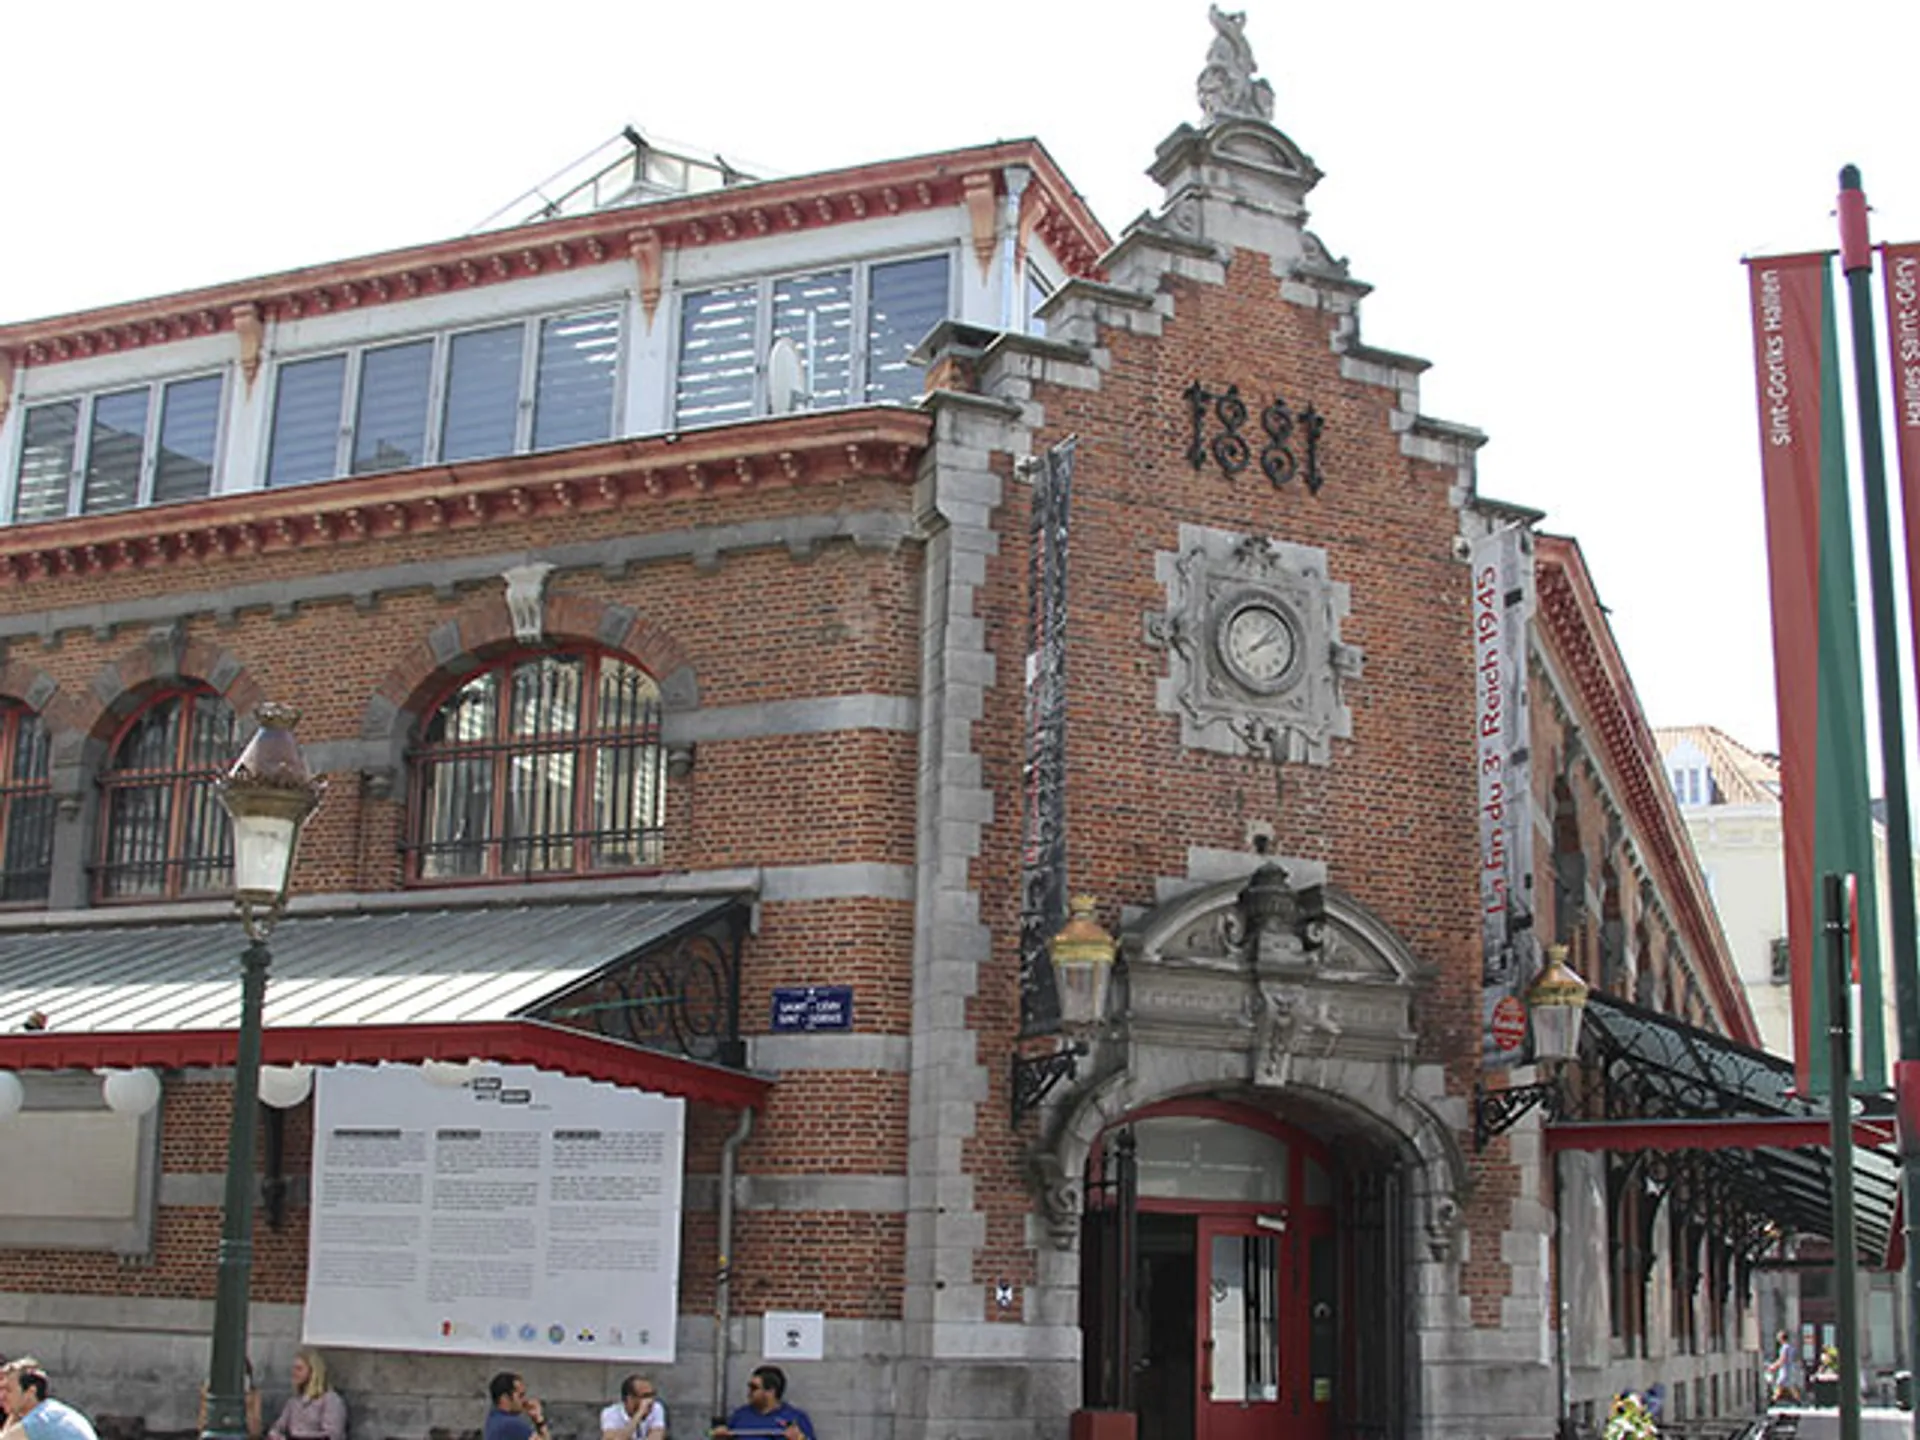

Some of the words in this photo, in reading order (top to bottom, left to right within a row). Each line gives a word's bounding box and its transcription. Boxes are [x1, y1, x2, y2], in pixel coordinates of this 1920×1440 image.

[1766, 337, 1791, 445] Sint-Goriks
[1903, 367, 1920, 426] Halles
[1183, 380, 1325, 497] 1881
[1476, 567, 1497, 644] 1945
[1480, 650, 1501, 737] Reich
[1482, 782, 1504, 821] du
[1483, 828, 1505, 871] fin
